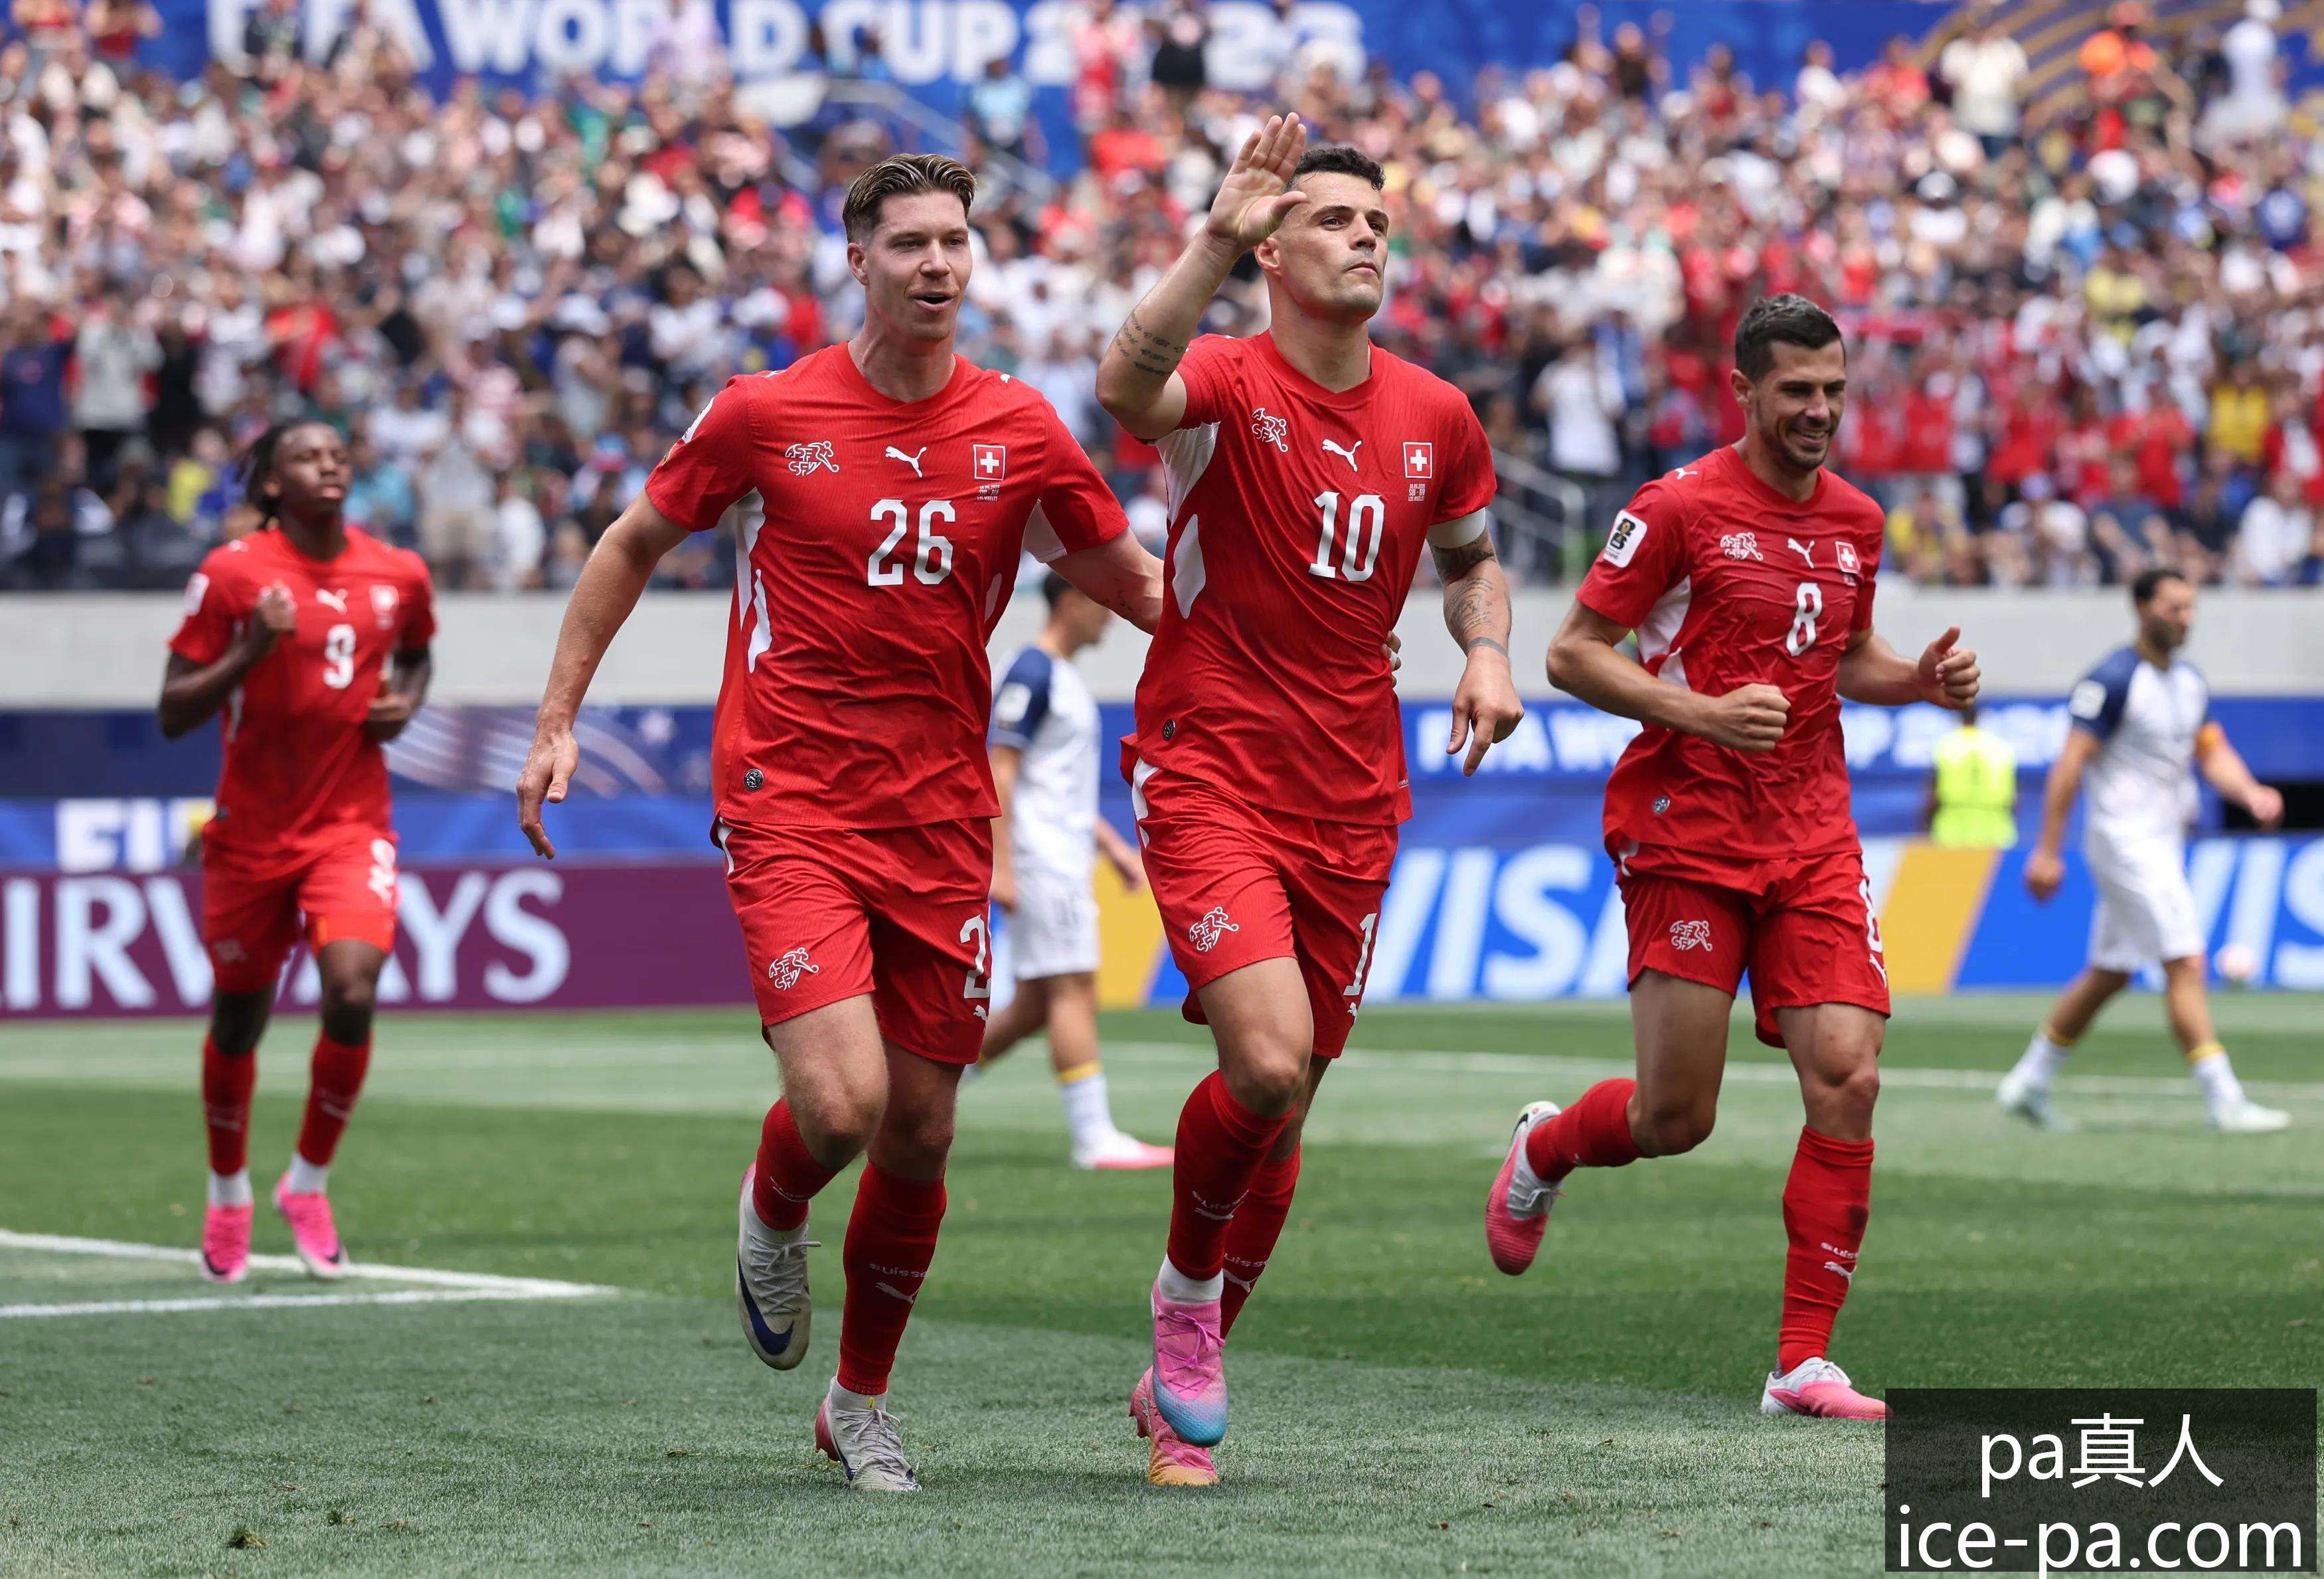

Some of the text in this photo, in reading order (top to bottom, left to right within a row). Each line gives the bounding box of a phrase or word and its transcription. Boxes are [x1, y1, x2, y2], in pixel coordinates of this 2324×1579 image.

[435, 0, 805, 76] WORD
[867, 499, 956, 587] 26
[1309, 491, 1385, 582] 10
[323, 623, 357, 689] 9
[1785, 582, 1823, 657] 8
